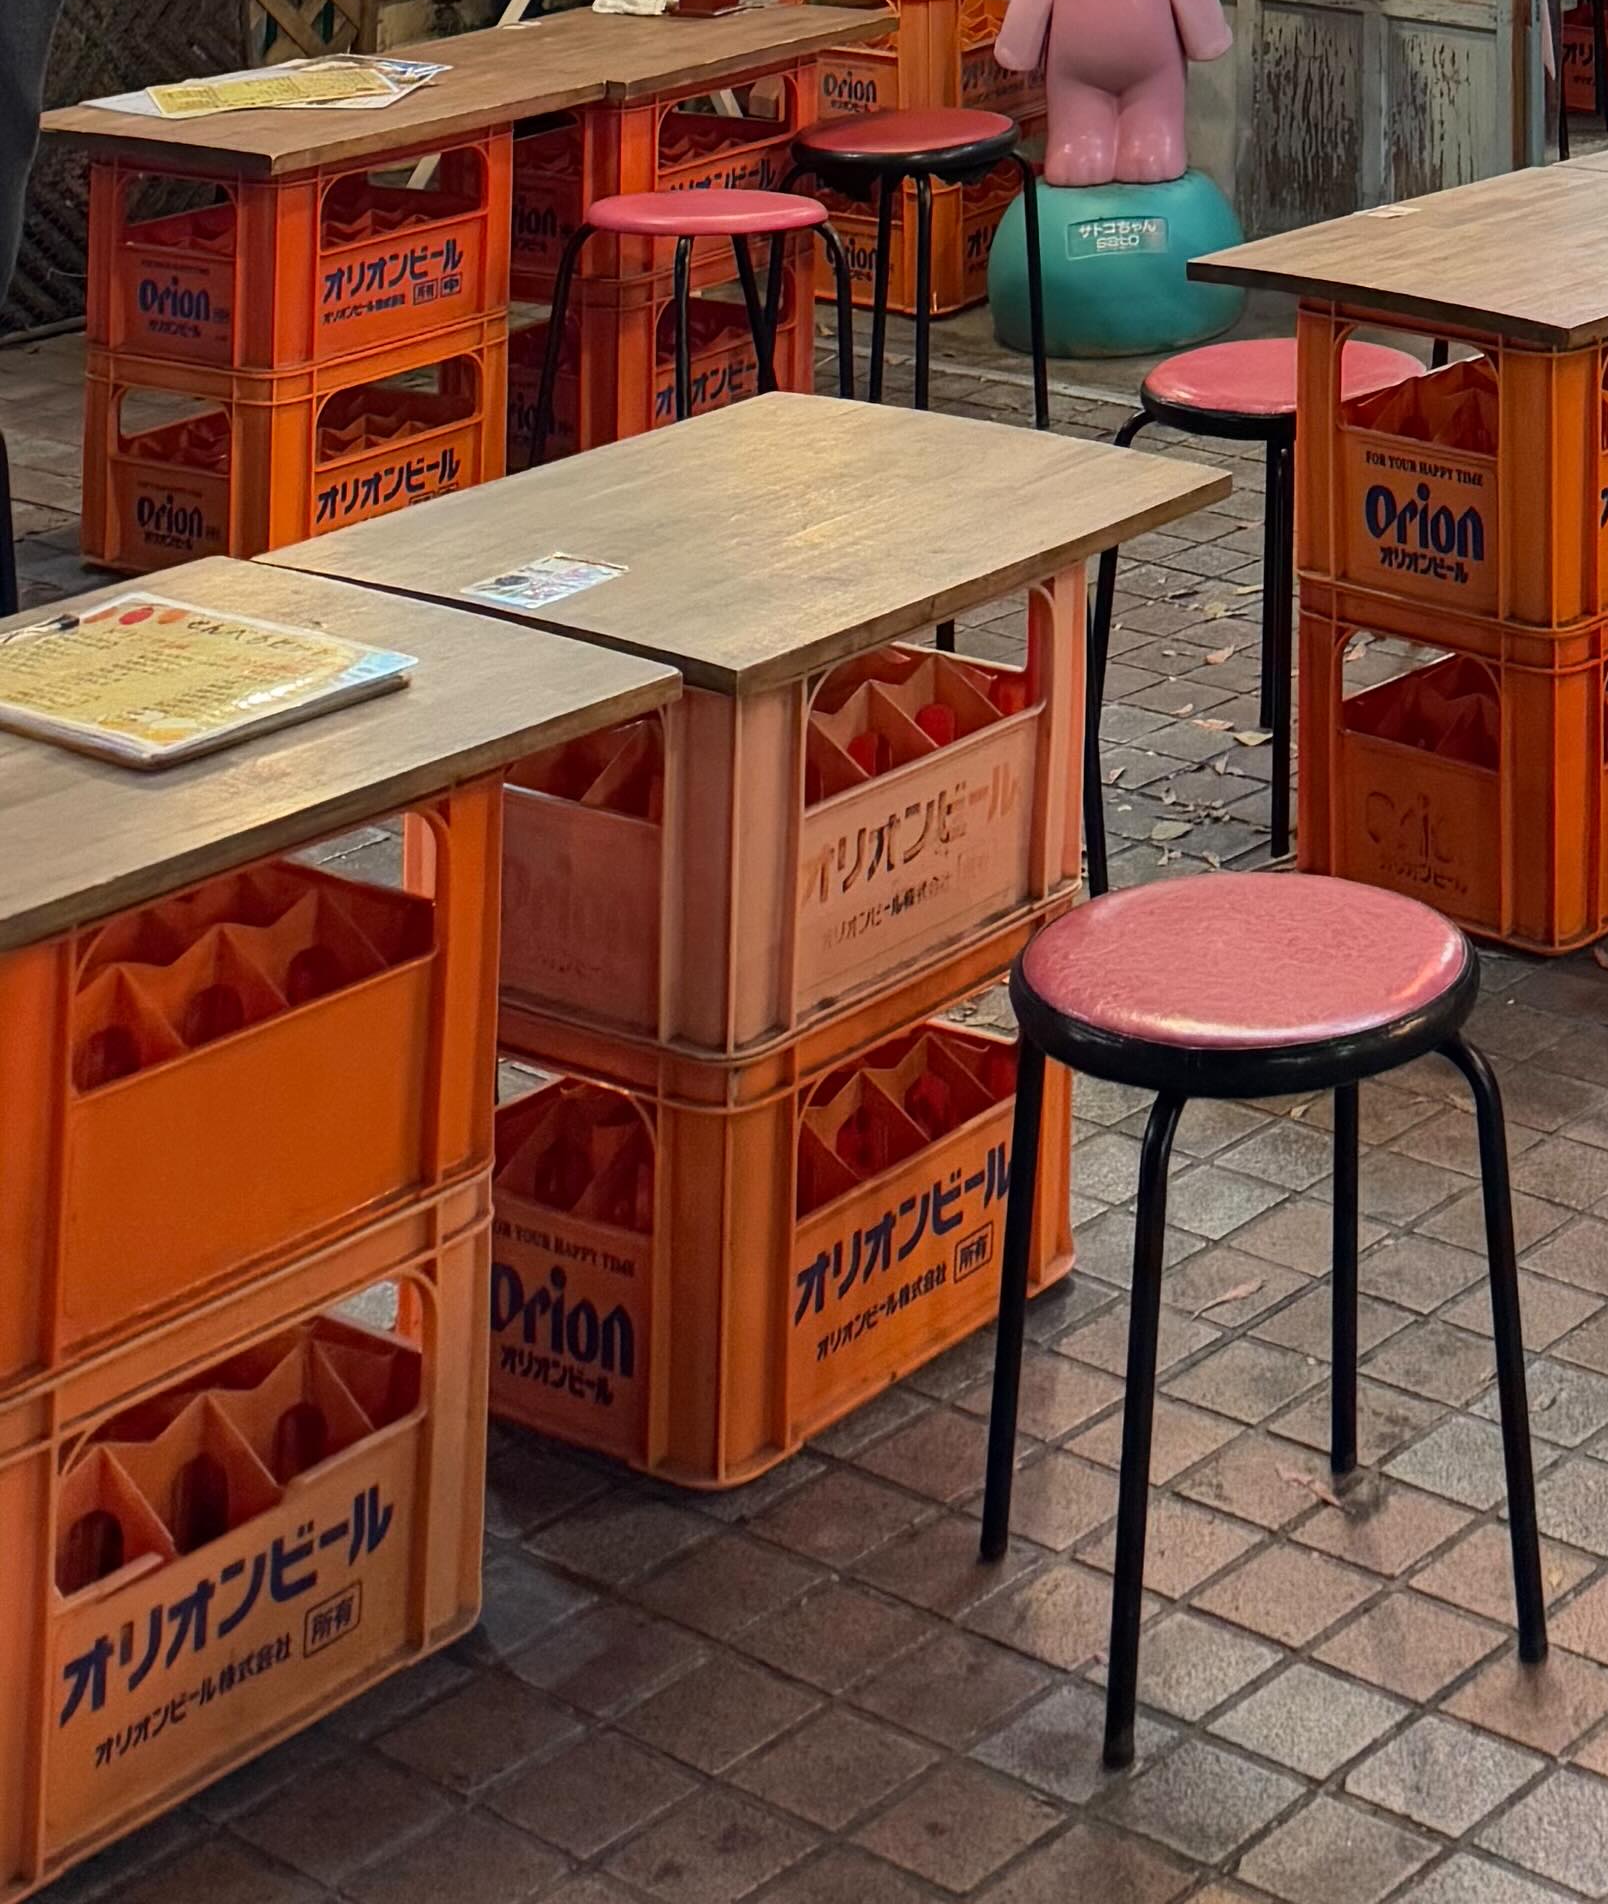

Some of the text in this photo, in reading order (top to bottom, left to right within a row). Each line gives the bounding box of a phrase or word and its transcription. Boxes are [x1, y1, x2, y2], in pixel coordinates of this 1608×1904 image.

[822, 70, 878, 104] Orion
[137, 274, 211, 324] Orion
[321, 238, 464, 305] オリオンビール
[315, 447, 462, 525] オリオンビール
[1419, 460, 1455, 482] HAPPY
[136, 493, 204, 537] Orion
[1365, 482, 1486, 562] Orion
[1379, 545, 1469, 585] オリオンビール
[794, 1140, 1012, 1327] オリオンビール
[490, 1260, 635, 1379] Orion
[816, 1260, 947, 1362] オリオンビール株式会社
[500, 1345, 614, 1407] オリオンビール
[58, 1483, 394, 1730] オリオンビール
[95, 1632, 293, 1770] オリオンビール株式会社
